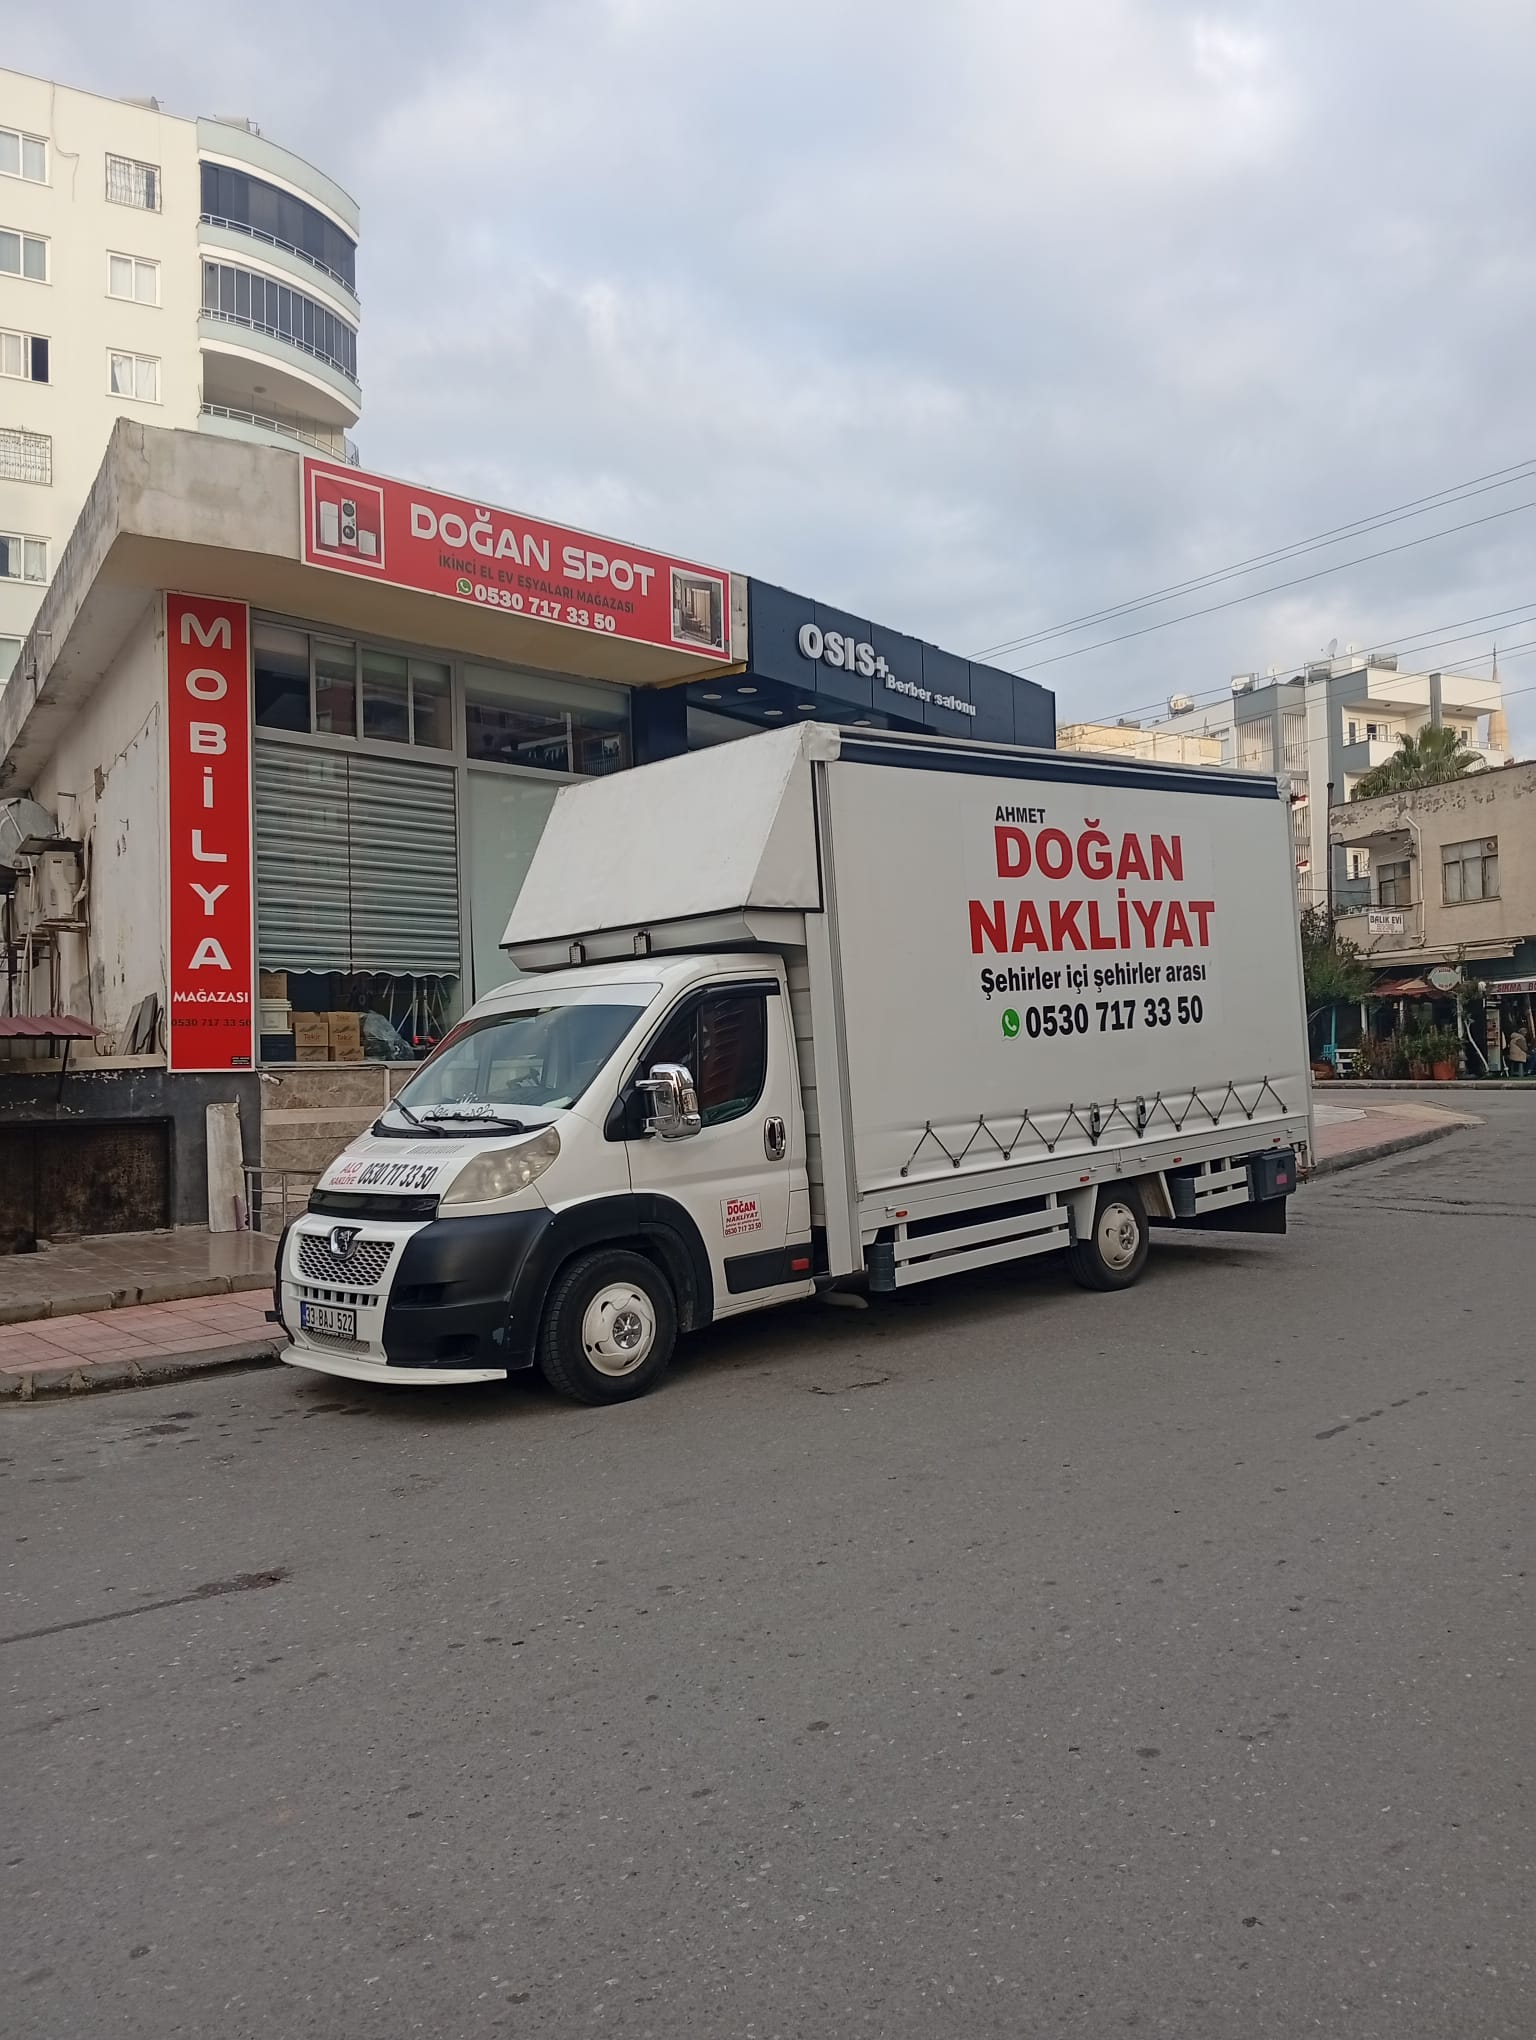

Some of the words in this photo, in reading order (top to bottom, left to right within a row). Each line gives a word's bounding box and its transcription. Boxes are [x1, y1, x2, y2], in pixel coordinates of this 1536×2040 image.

[410, 503, 550, 572] DOĞAN
[562, 546, 655, 596] SPOT
[439, 553, 477, 575] İKİNCİ
[480, 566, 494, 579] EL
[500, 570, 514, 584] EV
[518, 575, 573, 599] EŞYALARI
[576, 591, 634, 614] MAĞAZASI
[474, 584, 524, 609] 0530
[528, 597, 562, 619] 717
[566, 607, 589, 626] 33
[593, 613, 616, 631] 50
[885, 673, 932, 702] Berber
[934, 693, 977, 717] salonu
[995, 805, 1046, 824] AHMET
[994, 818, 1184, 881] DOĞAN
[968, 887, 1215, 954] NAKLİYAT
[173, 988, 249, 1003] MAĞAZASI
[980, 966, 1061, 1000] Şehirler
[1066, 963, 1089, 994] içi
[1093, 961, 1160, 993] şehirler
[1166, 963, 1206, 983] arası
[171, 1018, 197, 1027] 0530
[201, 1018, 219, 1027] 717
[223, 1018, 236, 1027] 33
[1025, 1003, 1089, 1038] 0530
[1095, 999, 1136, 1032] 717
[1143, 997, 1171, 1028] 33
[1177, 995, 1203, 1025] 50
[357, 1162, 390, 1185] 0530
[380, 1163, 409, 1186] 717
[399, 1164, 423, 1188] 33
[414, 1166, 439, 1189] 50
[306, 1307, 315, 1324] 33
[318, 1309, 334, 1328] BAJ
[337, 1312, 353, 1332] 522
